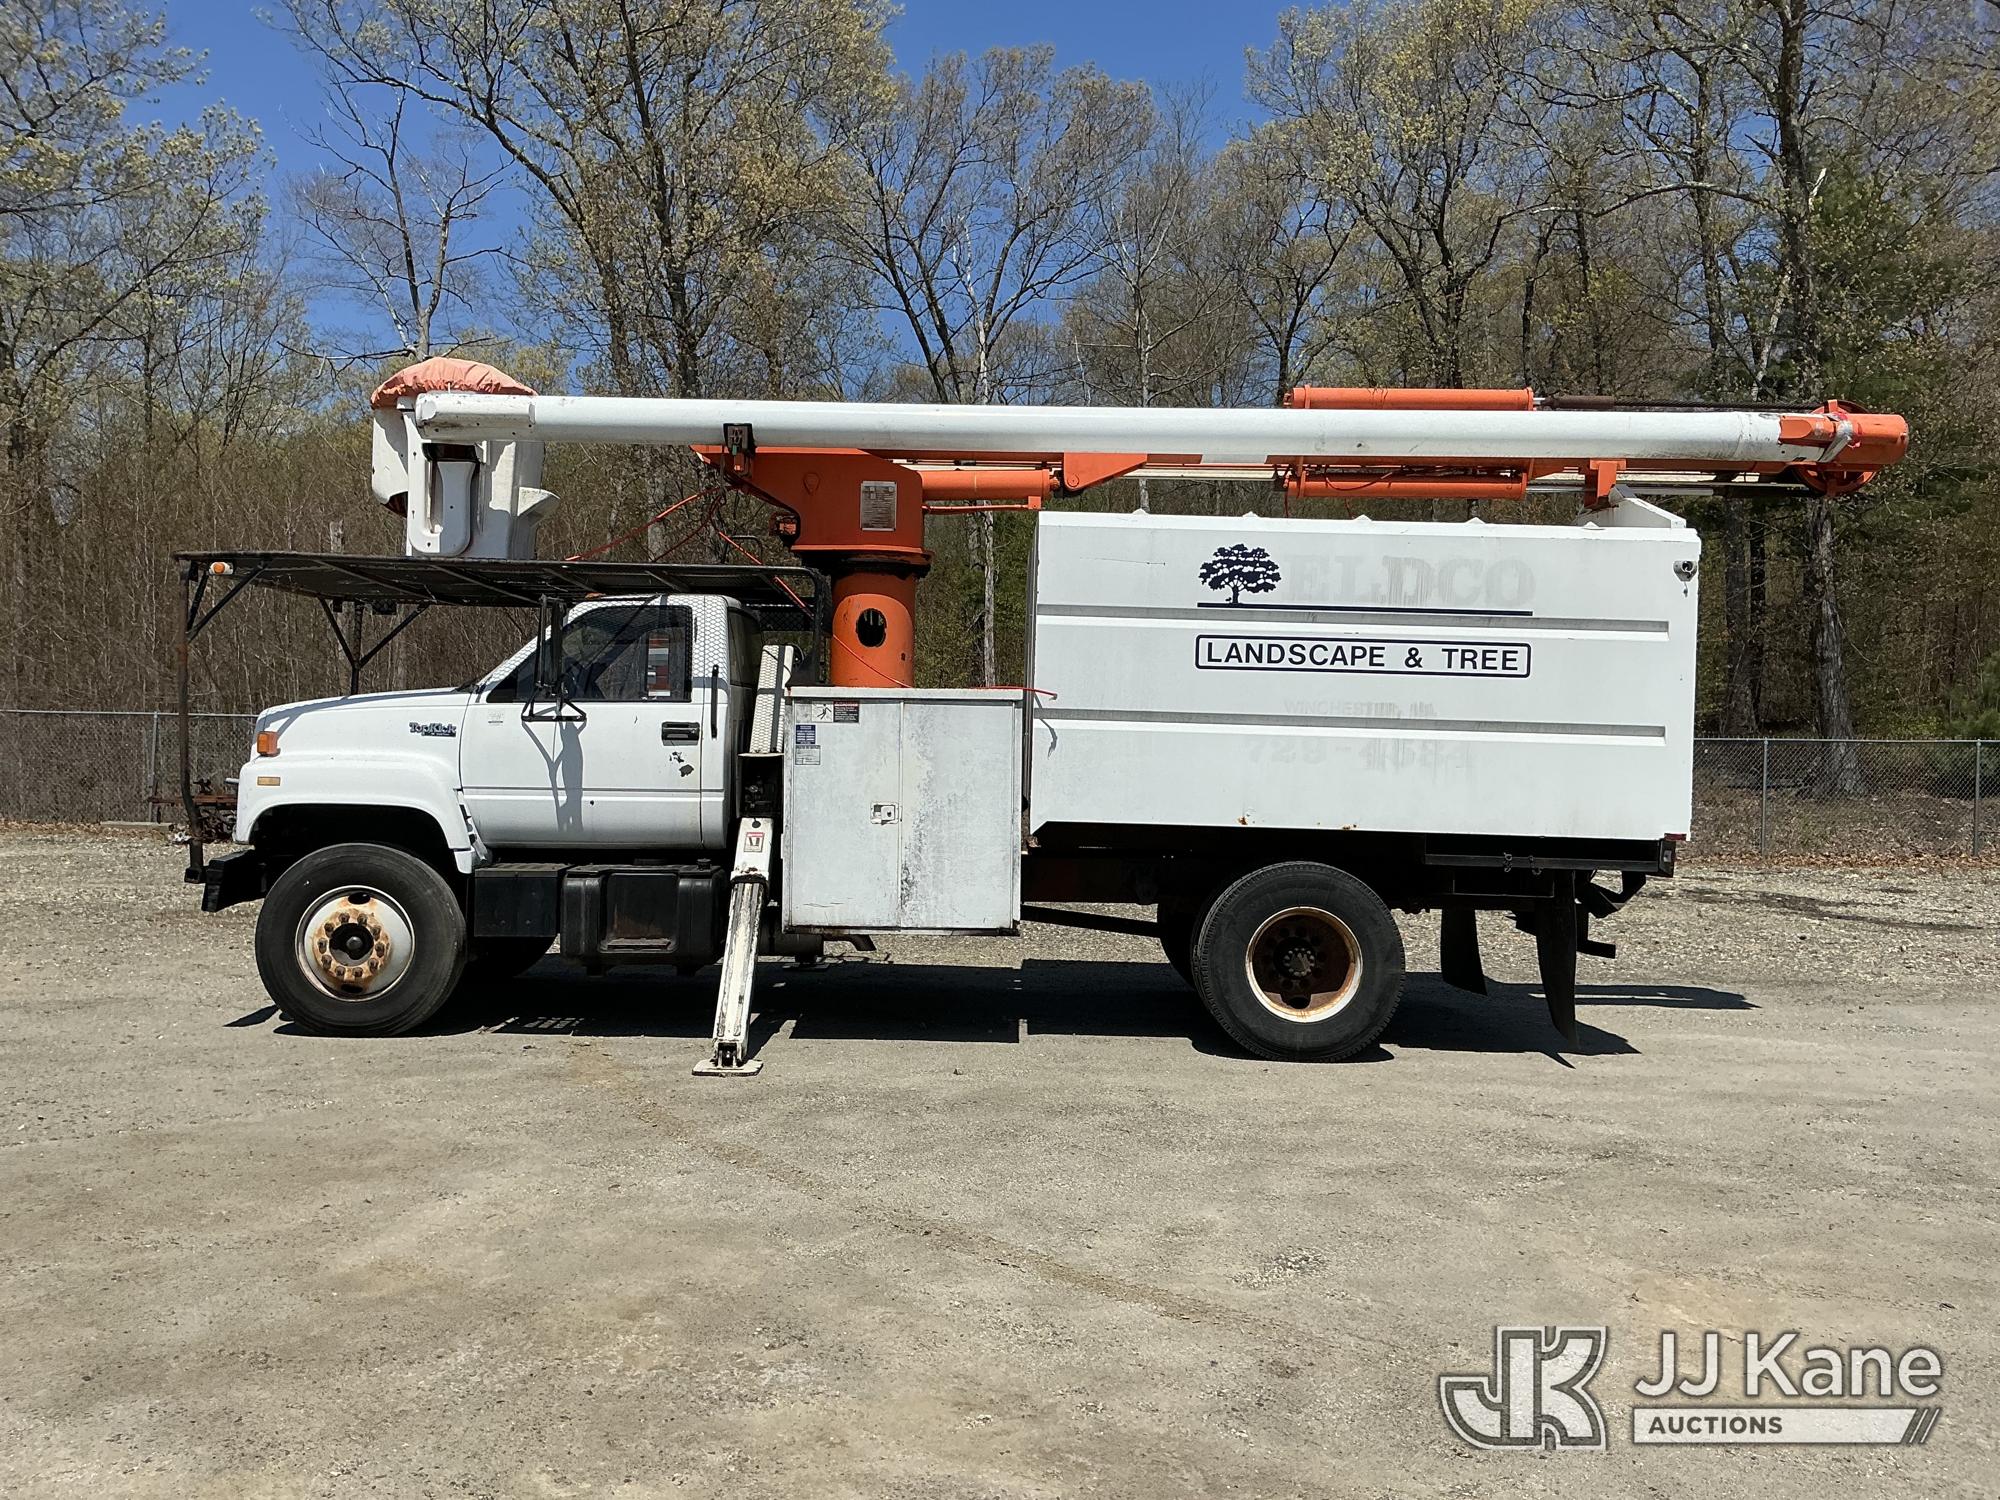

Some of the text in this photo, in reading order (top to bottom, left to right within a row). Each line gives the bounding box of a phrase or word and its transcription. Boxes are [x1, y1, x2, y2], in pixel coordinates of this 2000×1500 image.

[1281, 554, 1537, 606] ELDCO
[1206, 642, 1520, 671] LANDSCAPE & TREE
